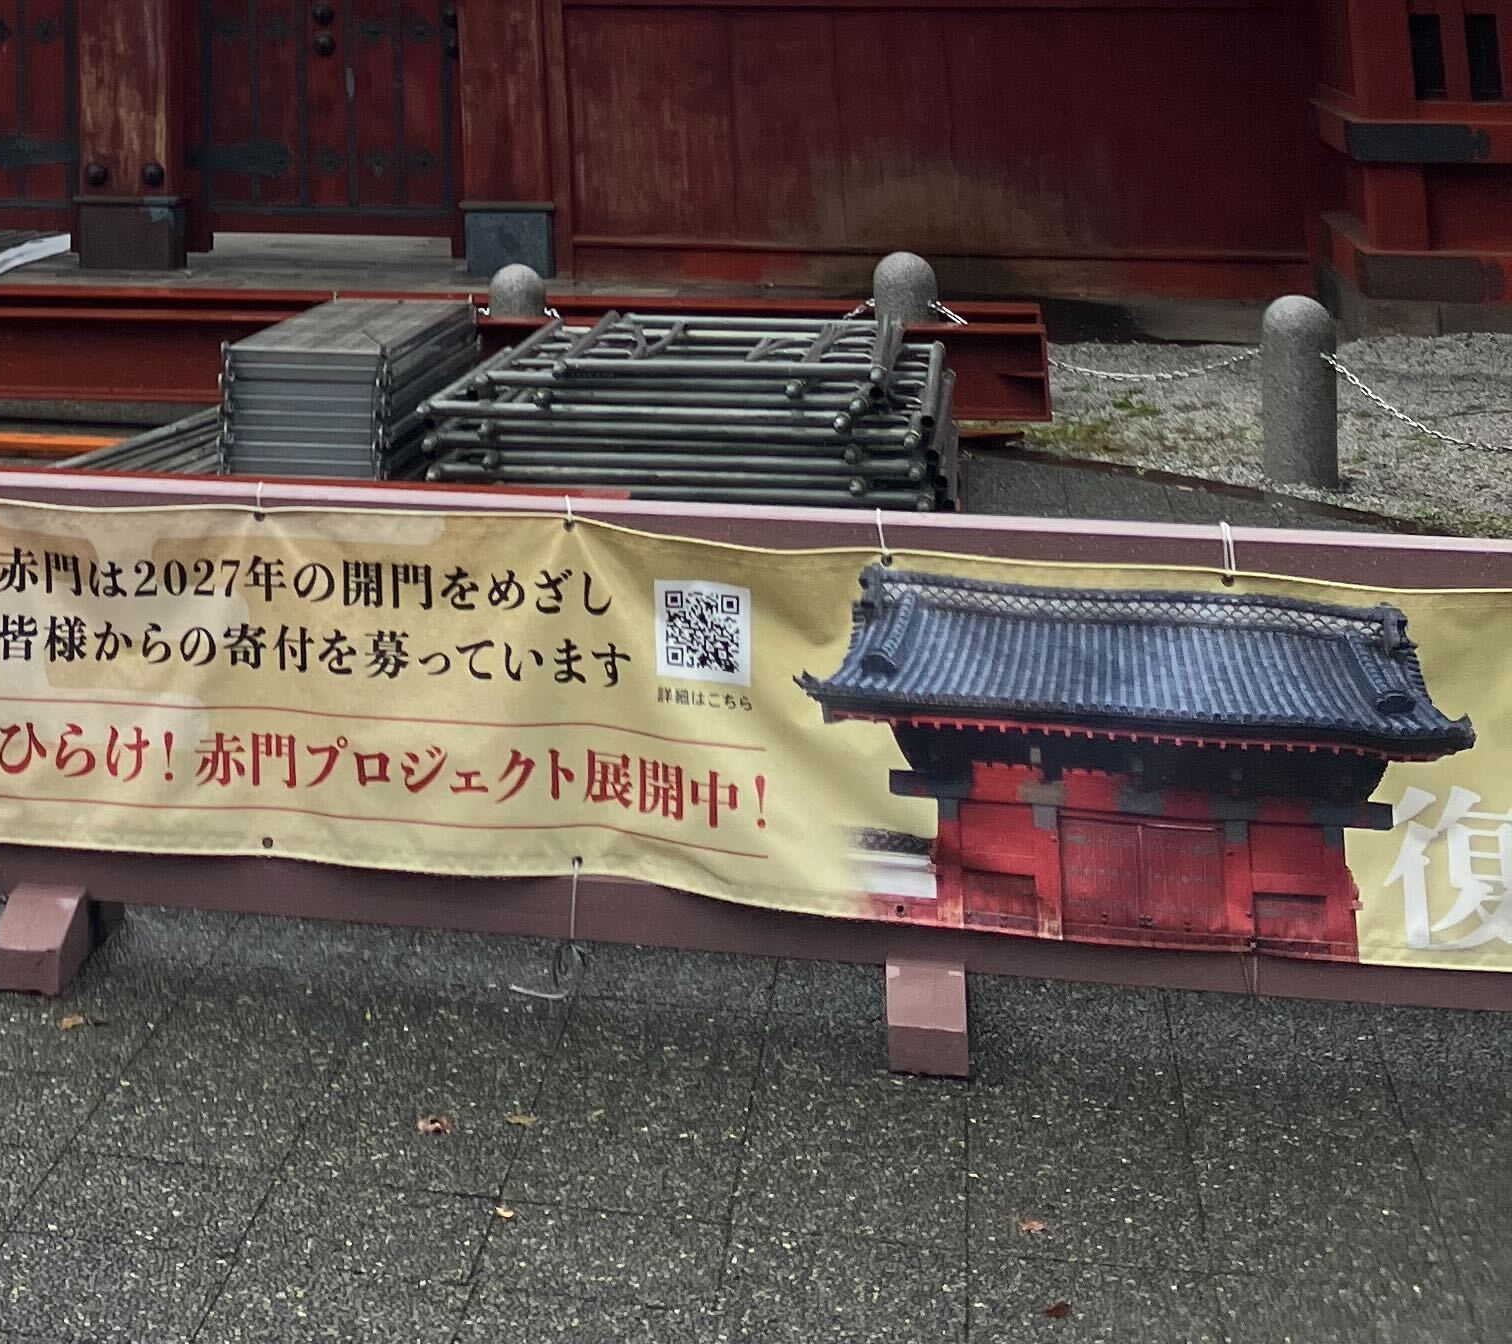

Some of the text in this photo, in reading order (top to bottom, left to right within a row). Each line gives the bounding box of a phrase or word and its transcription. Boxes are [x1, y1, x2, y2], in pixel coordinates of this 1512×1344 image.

[657, 687, 752, 712] 詳細はこちら
